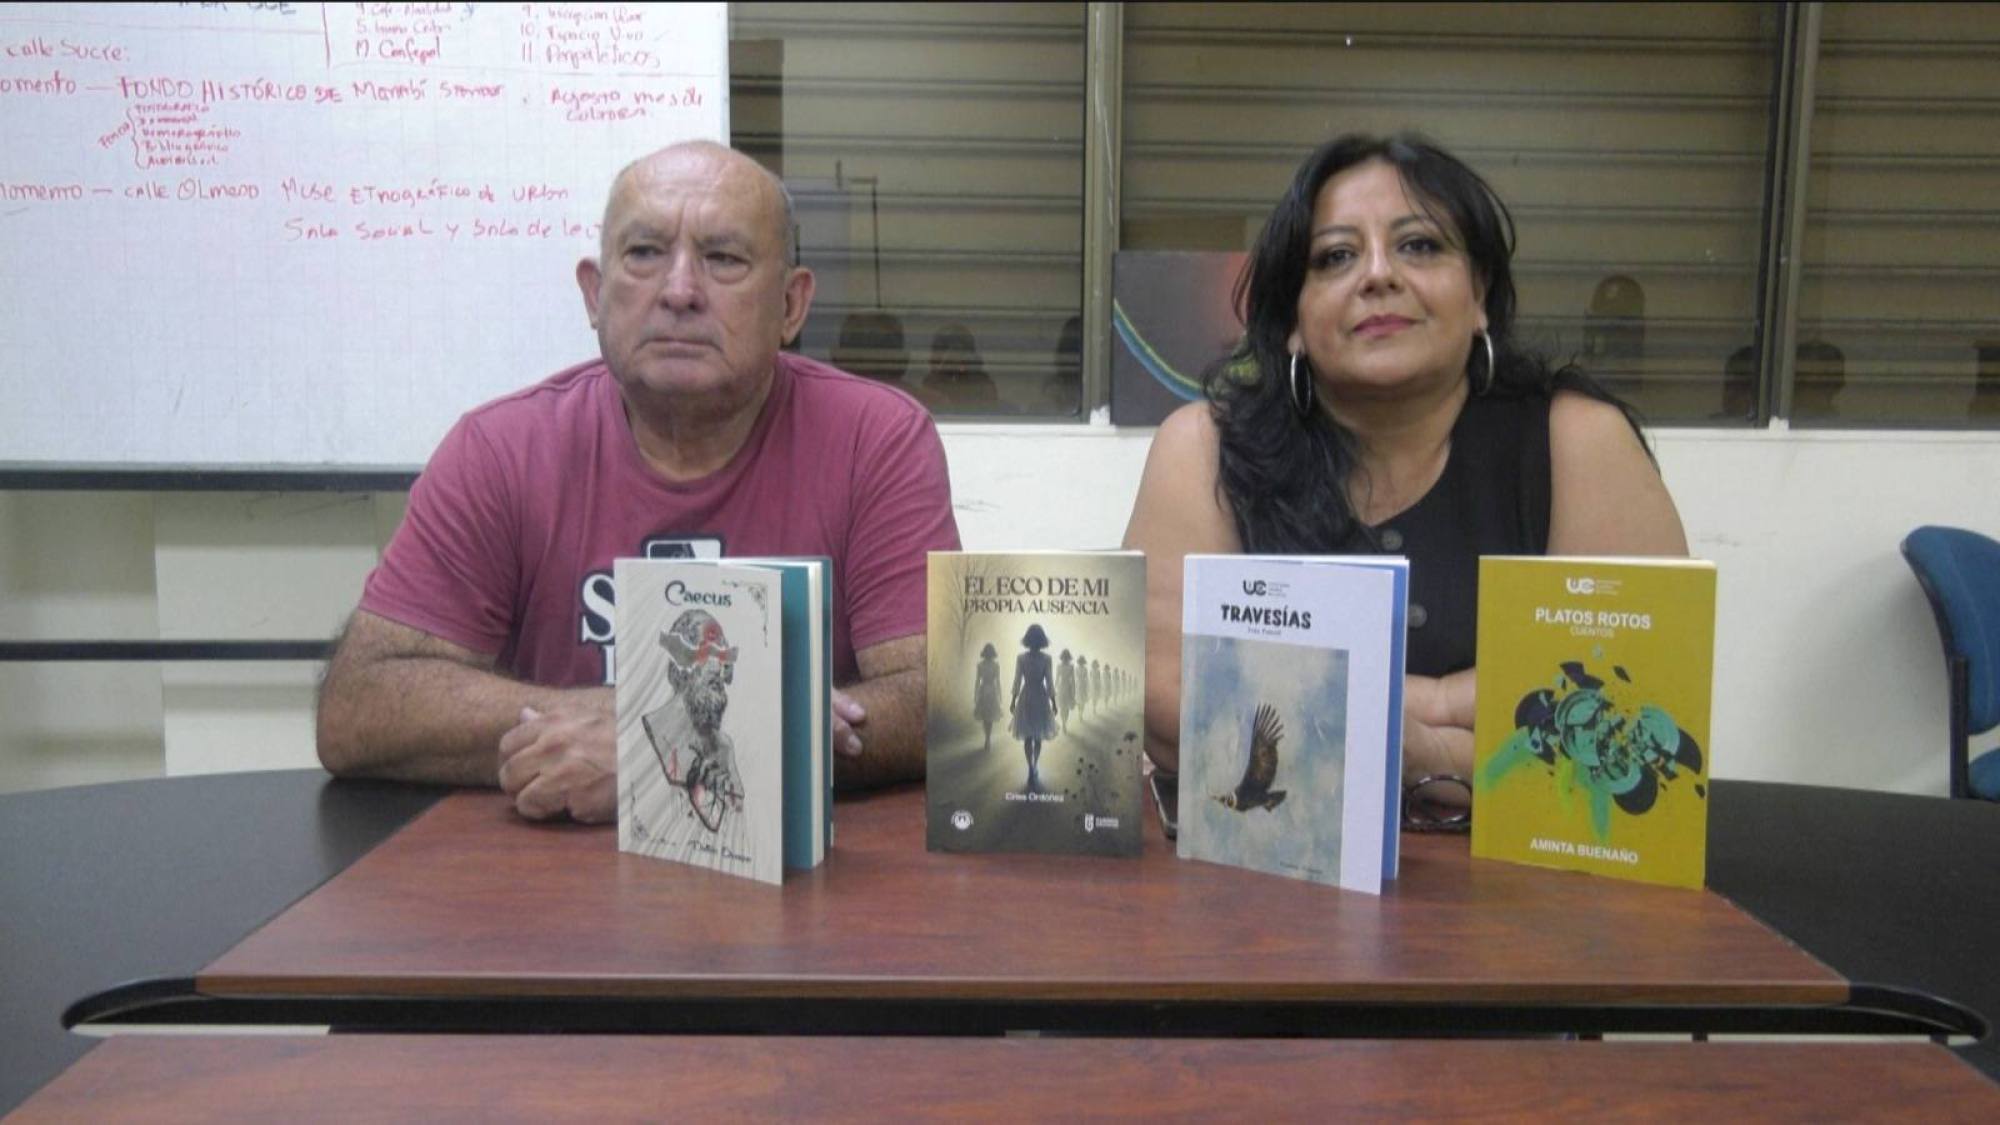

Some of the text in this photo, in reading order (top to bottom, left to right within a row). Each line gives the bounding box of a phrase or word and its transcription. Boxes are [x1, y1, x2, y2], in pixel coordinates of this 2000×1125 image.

[664, 579, 733, 608] Caecus
[964, 576, 1110, 598] EL ECO DE MI
[964, 598, 1110, 616] PROPIA AUSENCIA
[1221, 604, 1312, 631] TRAVESÍAS
[1535, 606, 1652, 631] PLATOS ROTOS
[1568, 625, 1616, 639] CUENTOS
[1529, 837, 1639, 865] AMINTA BUENAÑO
